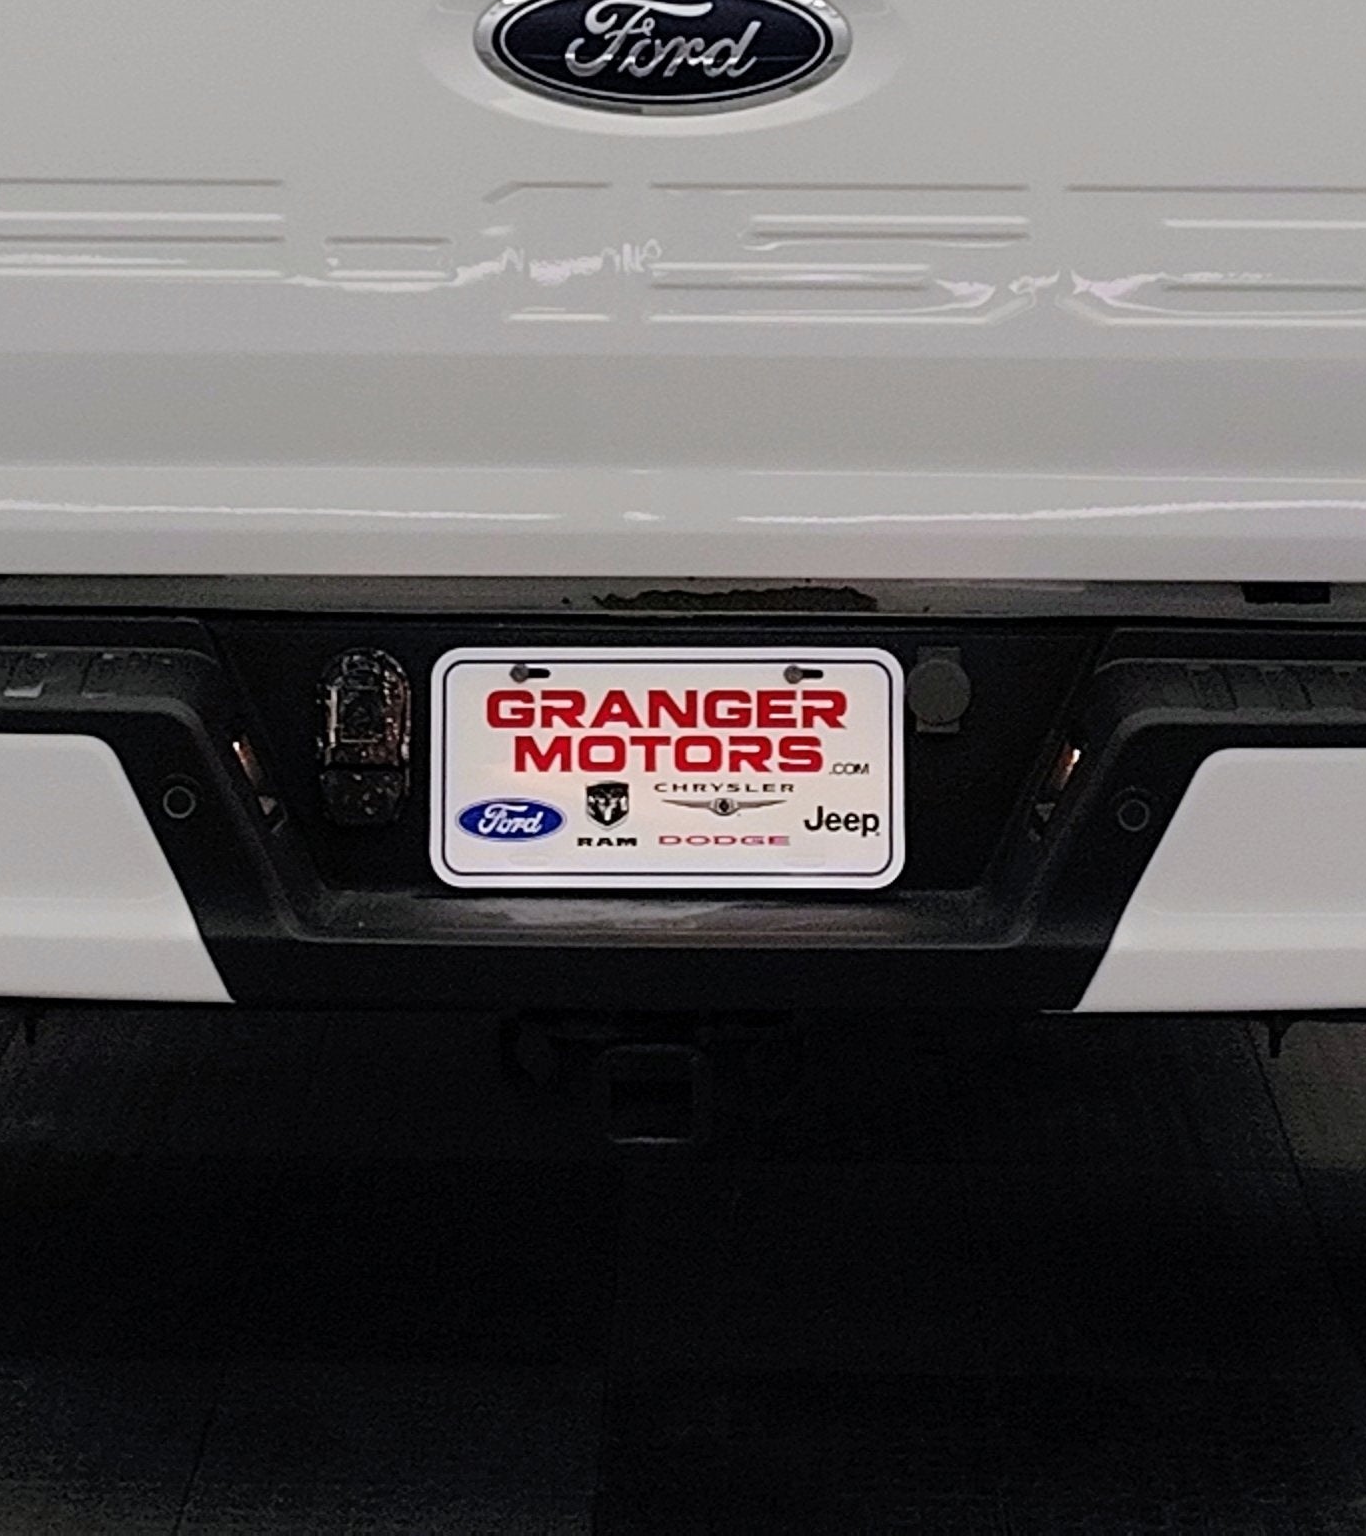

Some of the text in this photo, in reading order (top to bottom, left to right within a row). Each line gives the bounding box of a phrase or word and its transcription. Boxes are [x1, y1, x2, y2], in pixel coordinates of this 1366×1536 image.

[487, 690, 847, 729] GRANGER
[514, 736, 823, 772] MOTORS
[654, 782, 795, 793] CHRYSLER
[478, 804, 543, 834] Ford
[804, 806, 880, 837] Jeep
[576, 837, 638, 847] RAM
[657, 835, 791, 847] DODGE
